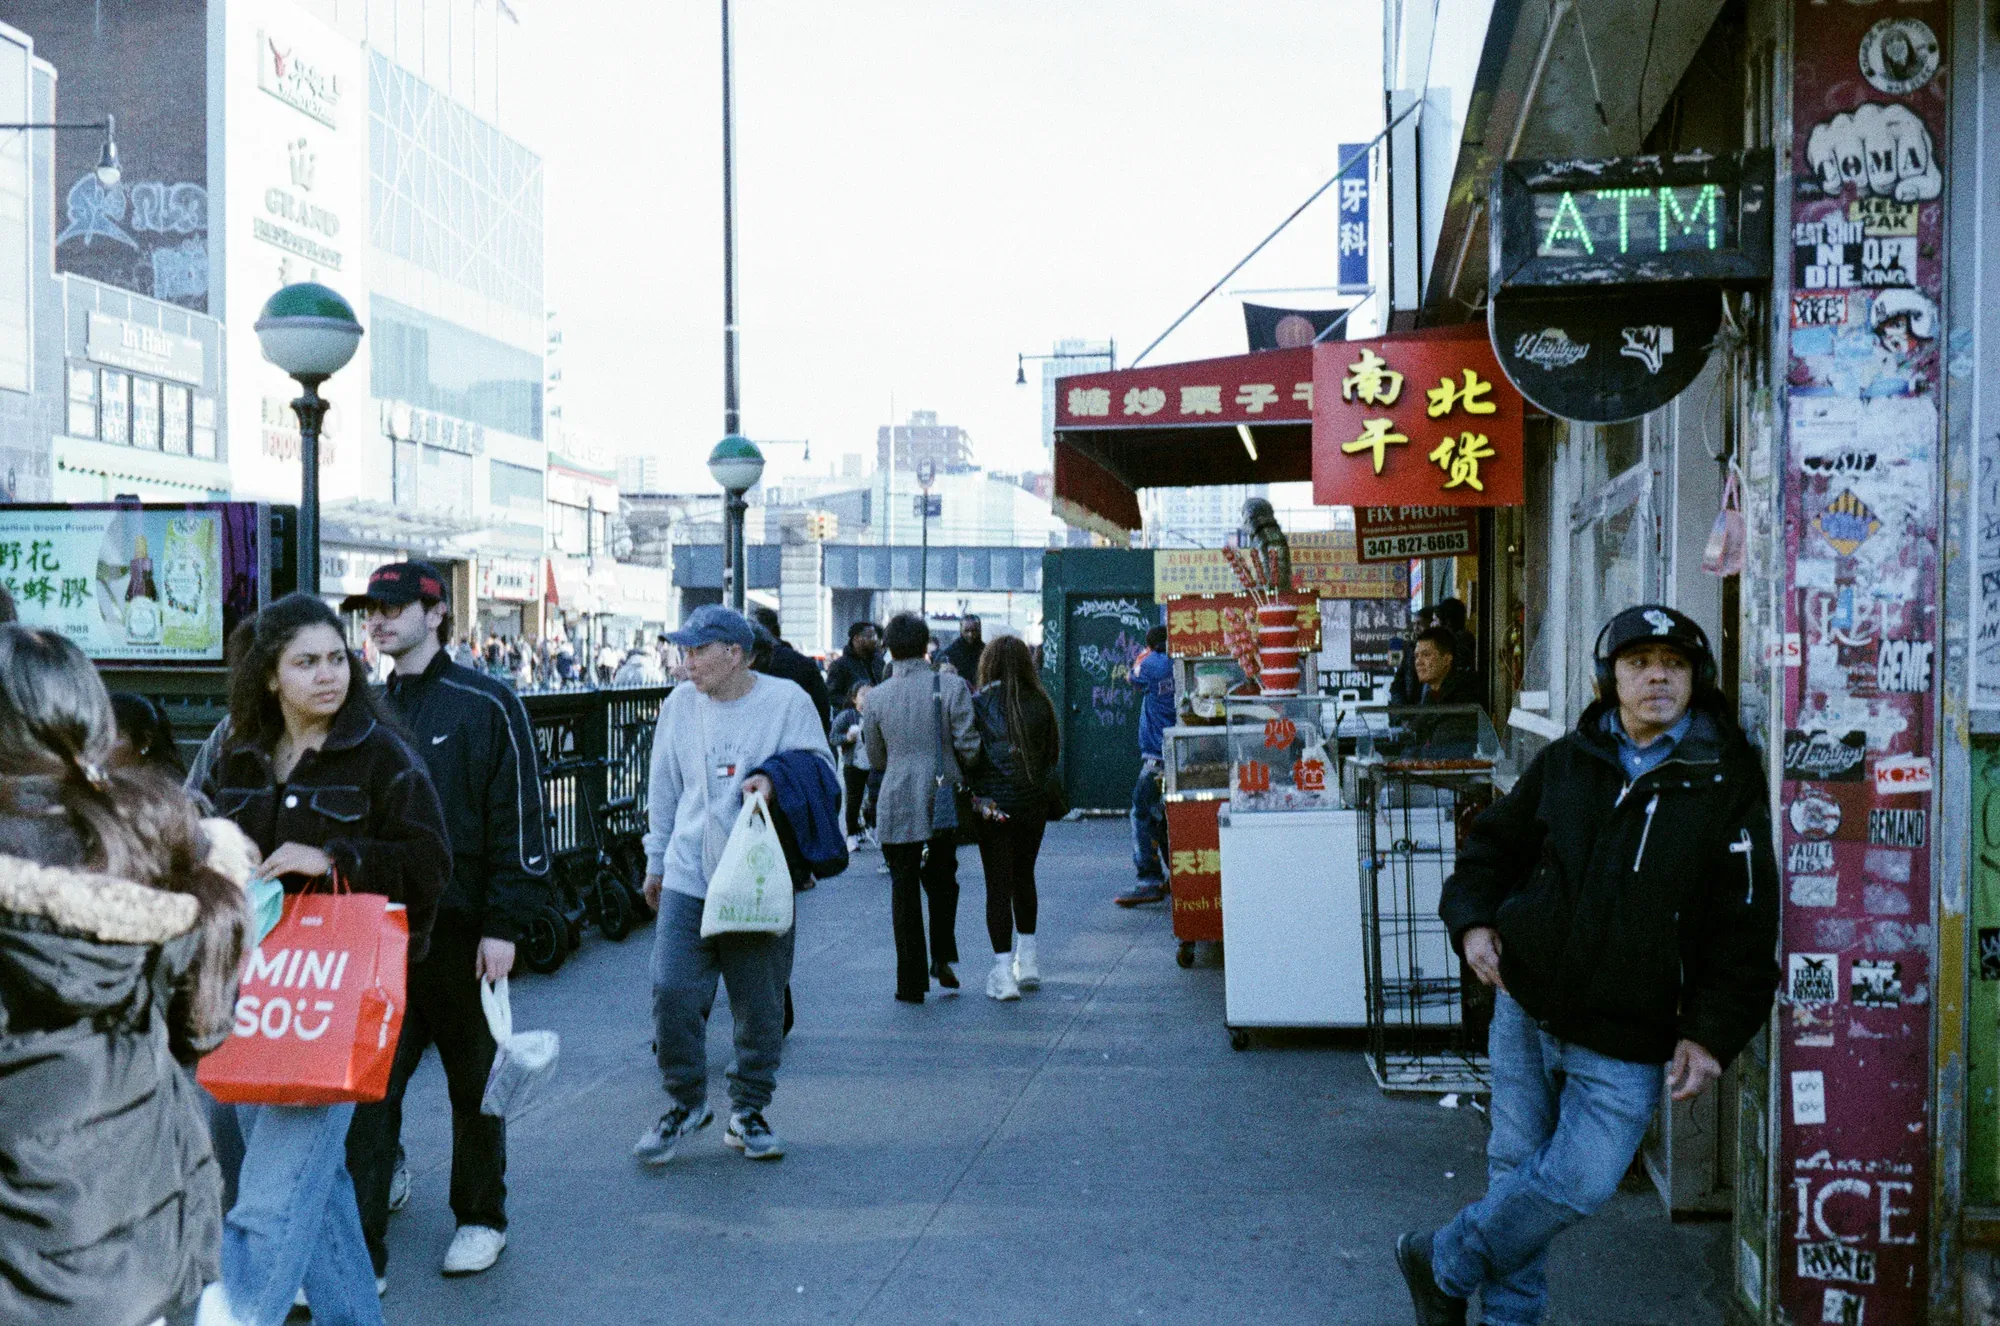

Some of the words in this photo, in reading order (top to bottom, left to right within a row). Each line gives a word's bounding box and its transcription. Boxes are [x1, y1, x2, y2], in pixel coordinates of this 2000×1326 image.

[264, 187, 340, 240] GRAND
[1340, 178, 1368, 257] 牙科
[1545, 184, 1717, 256] ATM
[1805, 265, 1855, 288] DIE
[1817, 244, 1844, 266] N
[1341, 348, 1497, 418] 南北
[1367, 506, 1394, 523] FIX
[1174, 895, 1210, 911] Fresh
[242, 947, 349, 991] MINI
[1791, 1177, 1918, 1245] ICE
